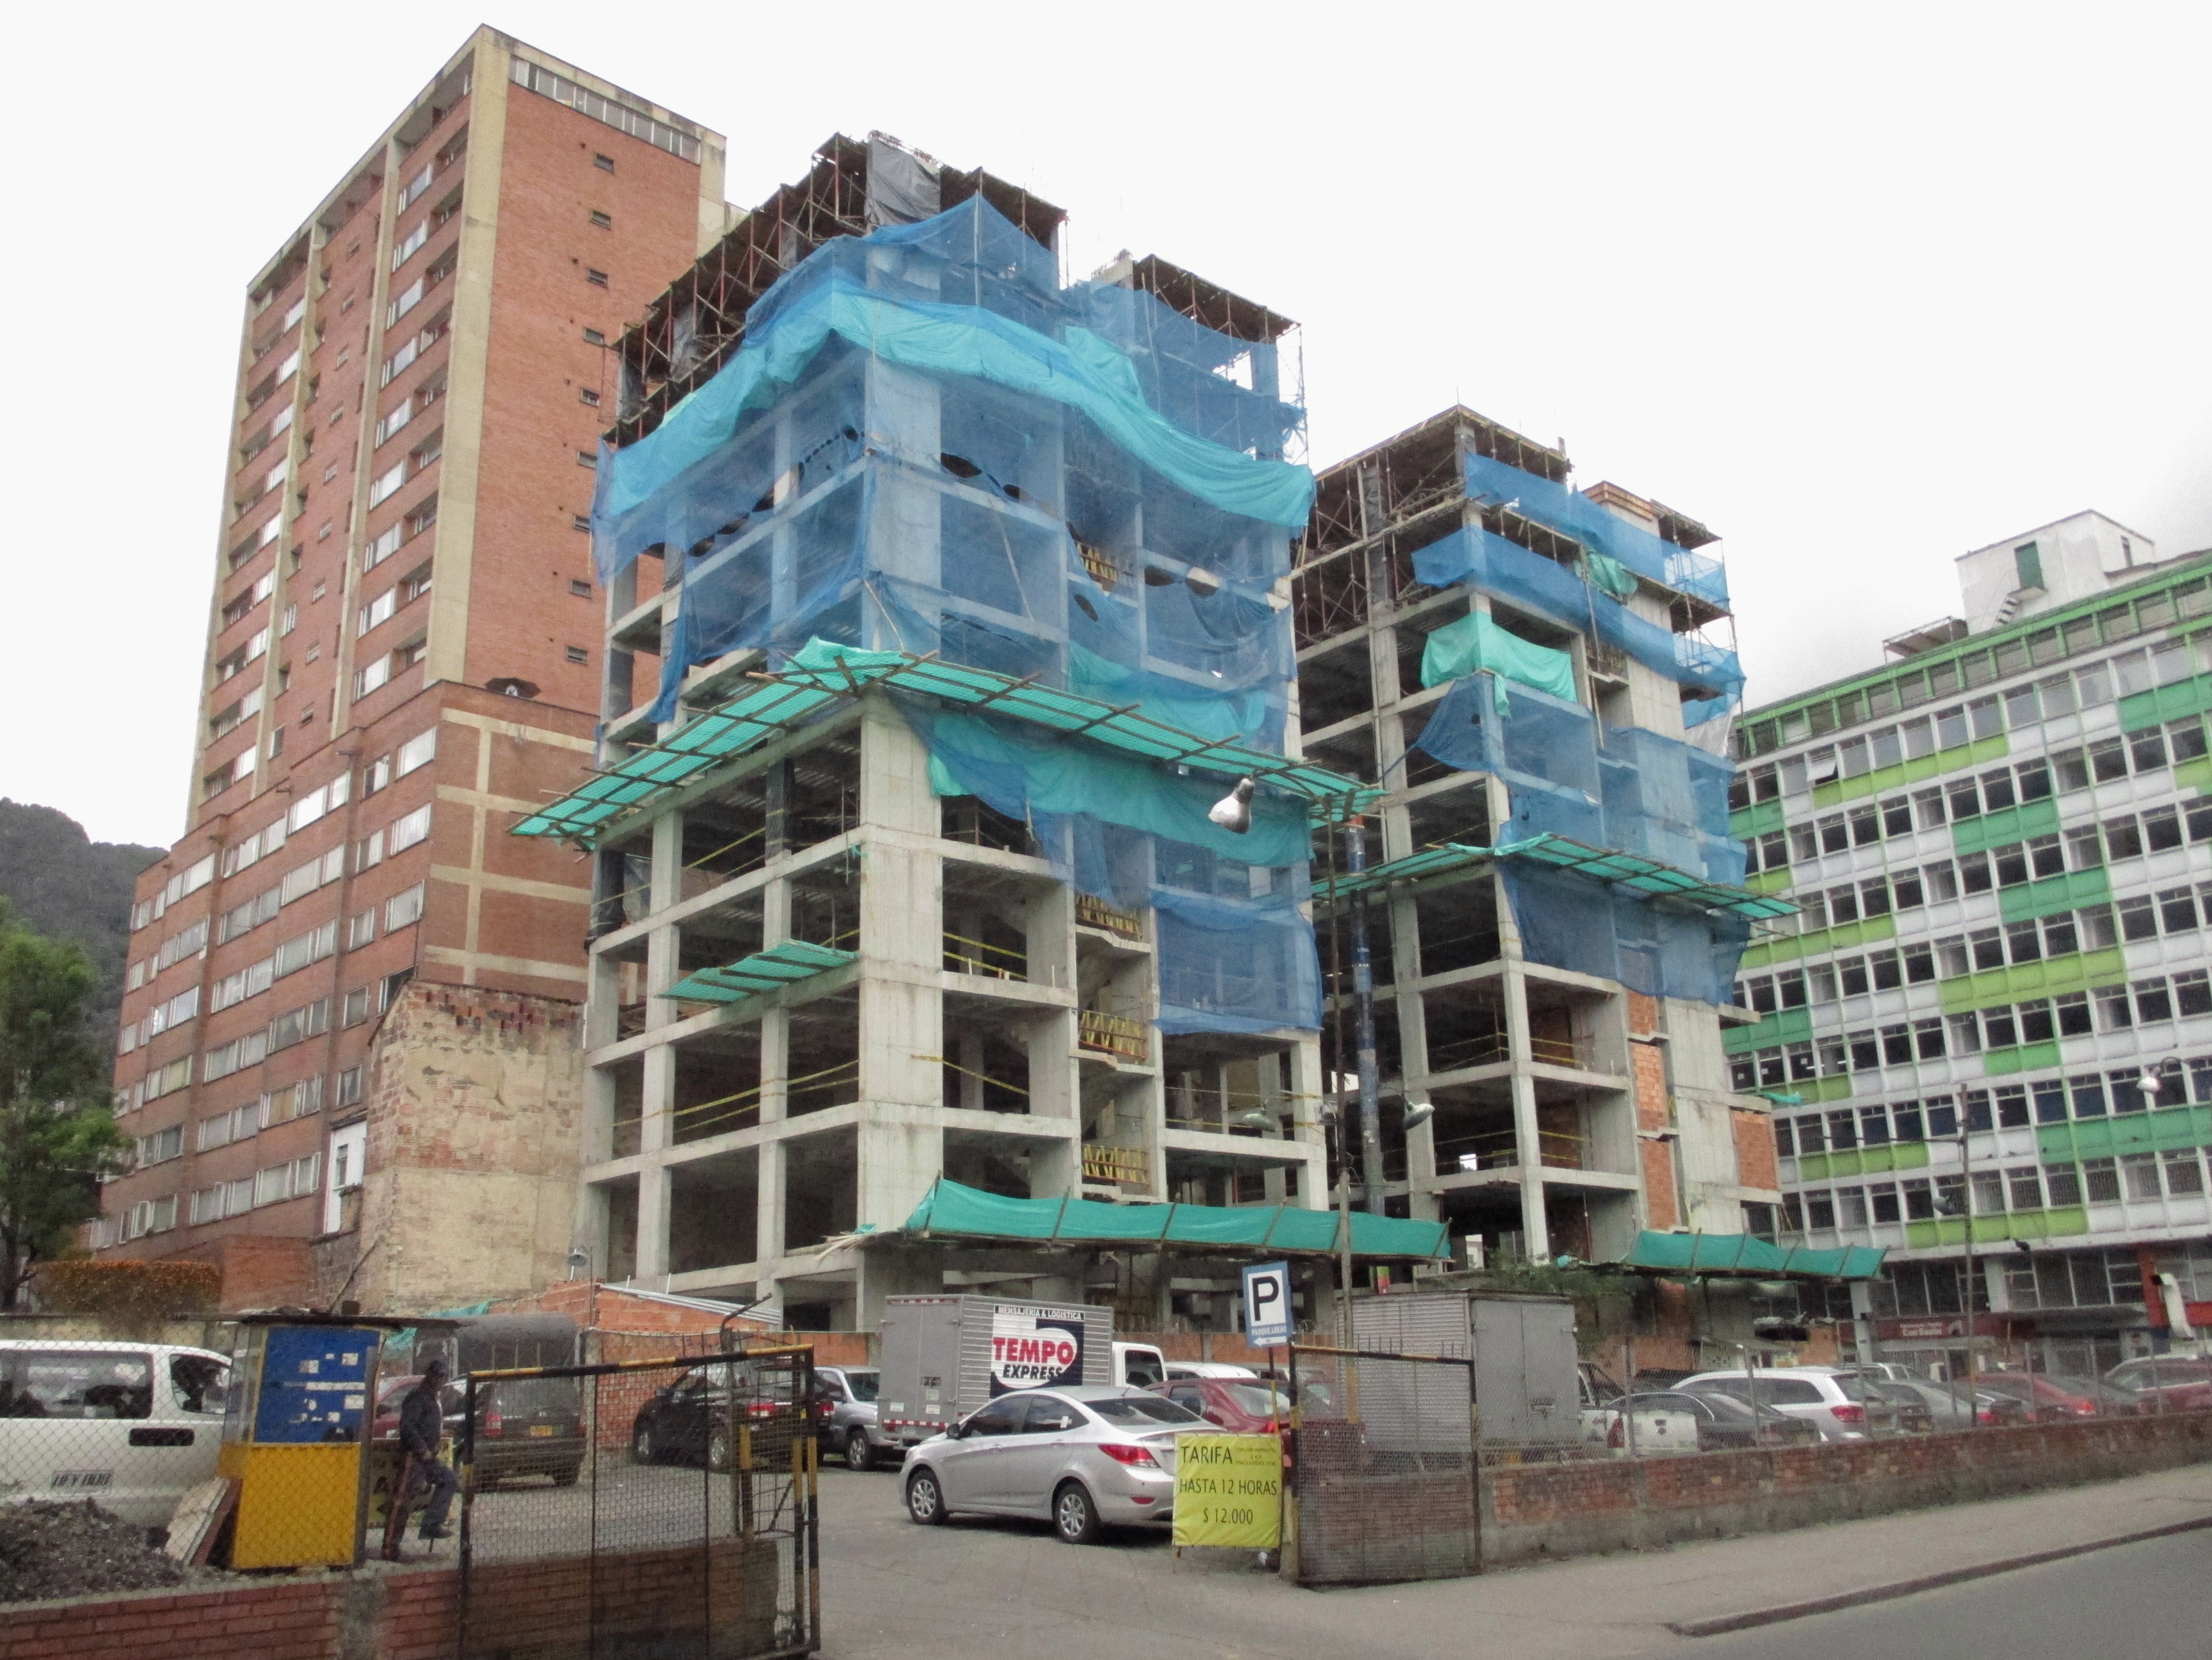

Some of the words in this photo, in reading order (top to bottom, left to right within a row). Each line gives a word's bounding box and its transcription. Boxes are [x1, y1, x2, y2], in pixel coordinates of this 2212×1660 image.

[1252, 1276, 1279, 1321] P
[998, 1306, 1040, 1317] MENSAJERIA
[1048, 1310, 1082, 1320] LOGISTICA
[1252, 1326, 1287, 1336] PARQUEADERO
[993, 1337, 1074, 1365] TEMPO
[1003, 1364, 1063, 1380] EXPRESS
[1180, 1446, 1233, 1464] TARIFA
[1180, 1478, 1217, 1494] HASTA
[1222, 1479, 1234, 1494] 12
[1239, 1480, 1277, 1495] HORAS
[1203, 1507, 1209, 1523] $
[1215, 1508, 1253, 1524] 12.000
